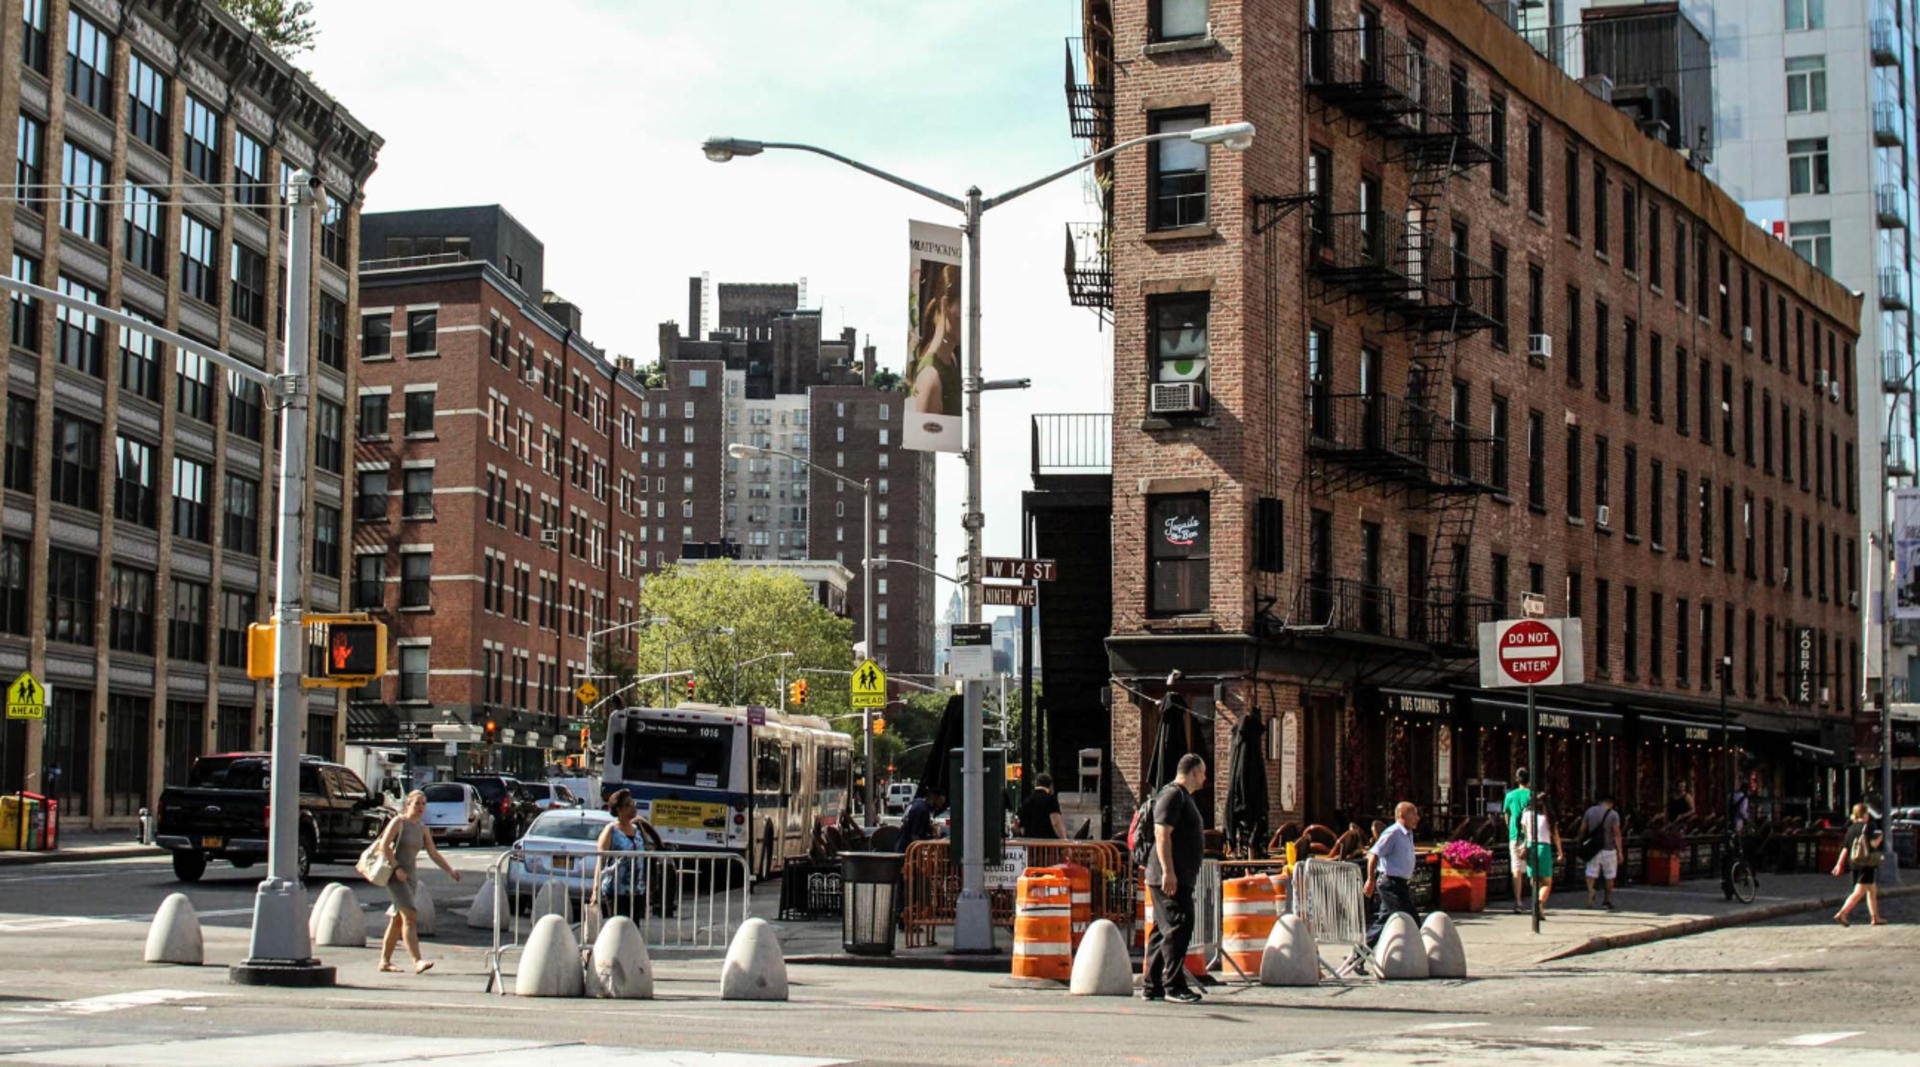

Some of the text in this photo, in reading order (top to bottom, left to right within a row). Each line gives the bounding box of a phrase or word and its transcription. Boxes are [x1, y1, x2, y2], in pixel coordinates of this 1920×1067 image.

[992, 561, 1052, 579] W 14 ST
[985, 588, 1034, 606] NINTH AVE
[1508, 632, 1549, 644] DO NOT
[1512, 661, 1548, 672] ENTER
[1800, 629, 1811, 702] KOBRICK
[854, 697, 883, 705] AHEAD
[1401, 696, 1440, 713] DOS CAMINOS
[11, 705, 40, 715] AHEAD
